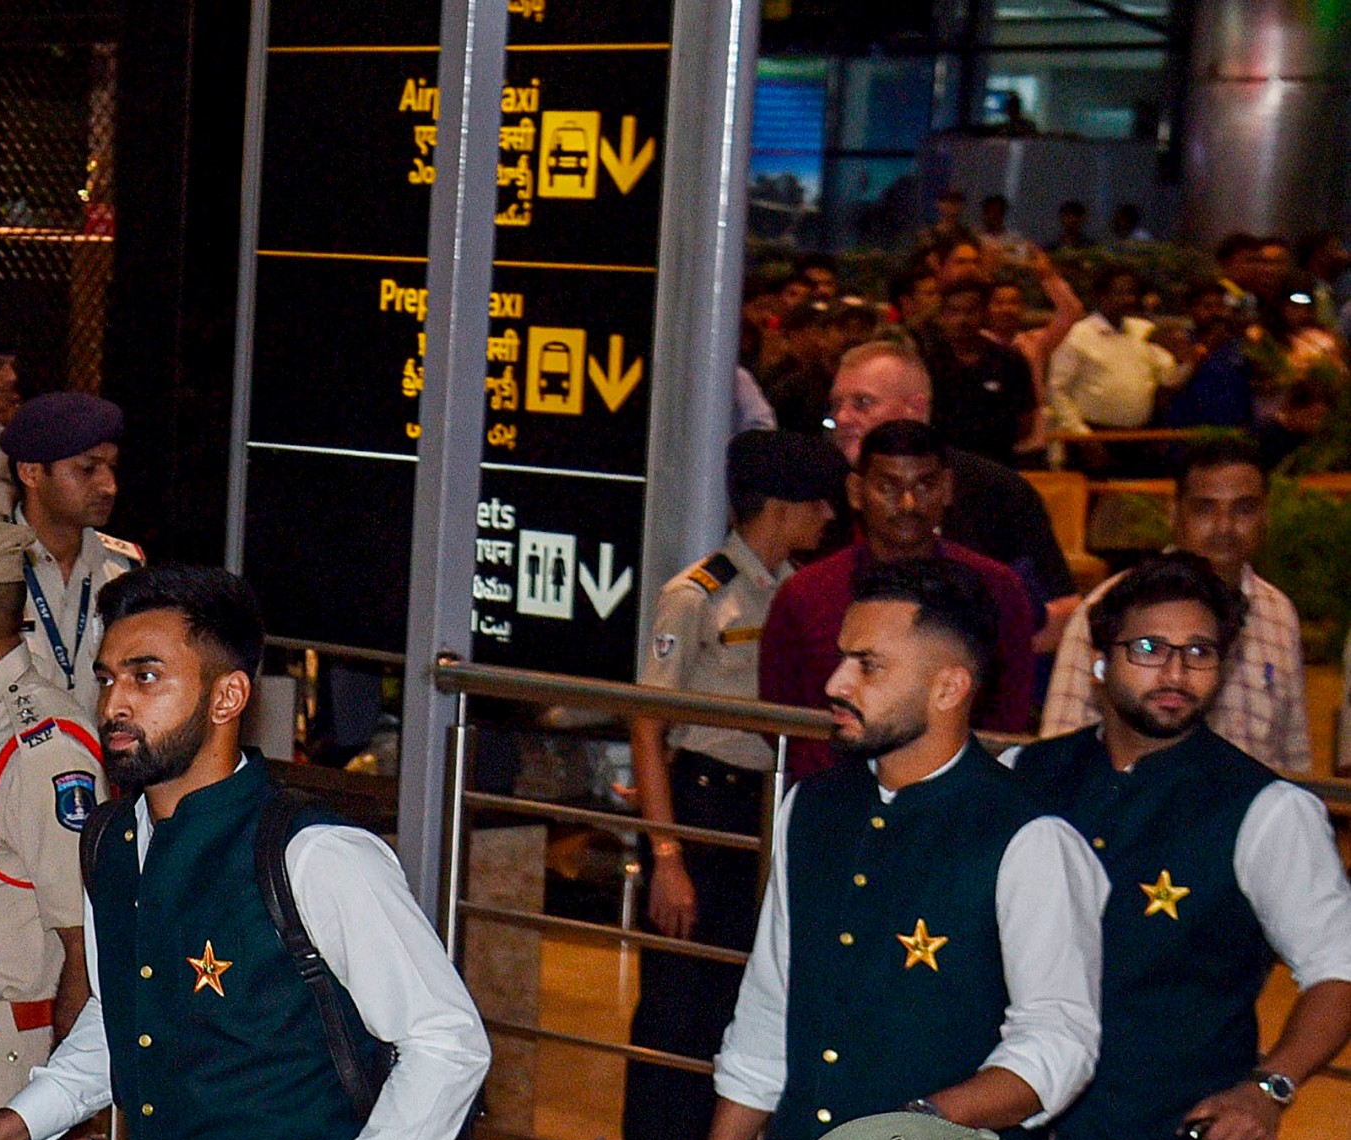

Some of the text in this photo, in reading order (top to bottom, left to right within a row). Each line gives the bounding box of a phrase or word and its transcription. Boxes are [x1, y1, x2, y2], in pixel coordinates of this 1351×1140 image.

[501, 78, 540, 113] axi
[380, 279, 523, 322] Prep axi
[476, 497, 516, 531] ets
